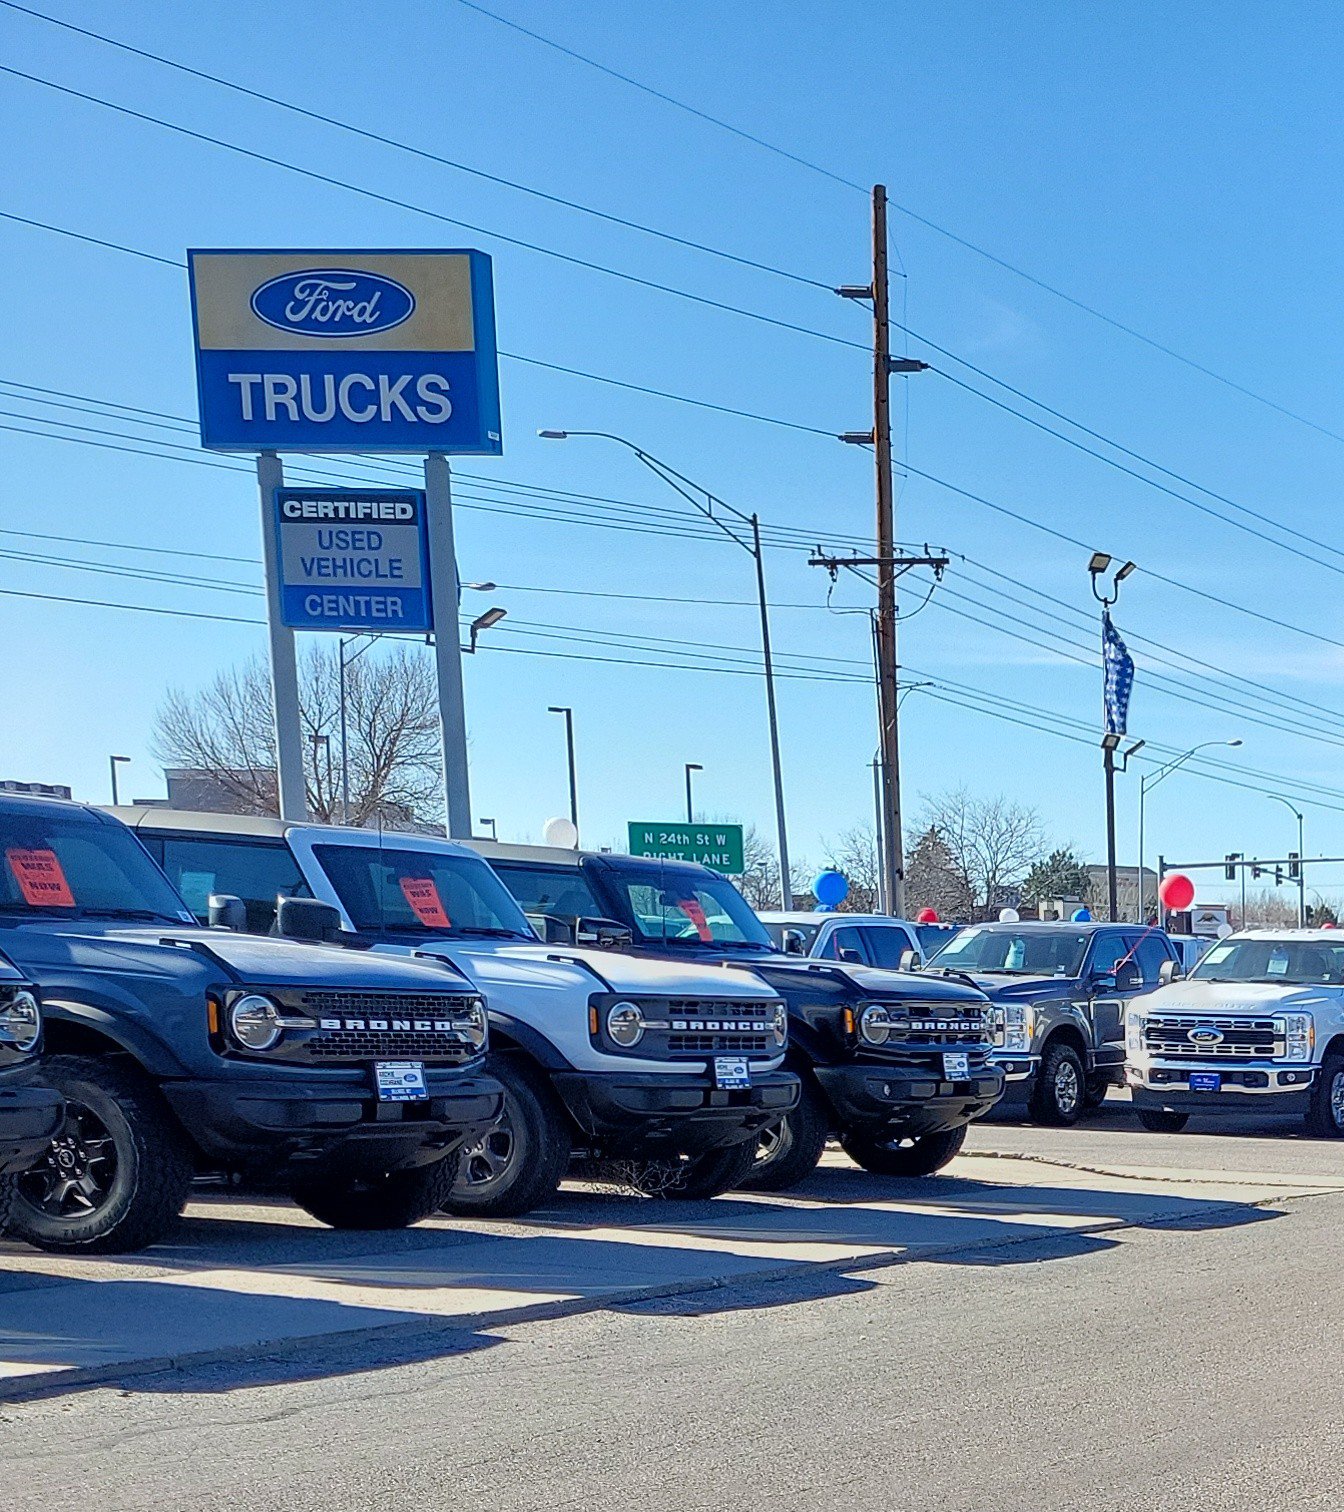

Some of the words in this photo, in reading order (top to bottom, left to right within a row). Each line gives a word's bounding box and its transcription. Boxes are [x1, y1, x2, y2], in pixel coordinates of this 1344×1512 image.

[285, 279, 381, 324] Ford
[228, 374, 453, 424] TRUCKS
[282, 499, 414, 520] CERTIFIED
[317, 529, 383, 551] USED
[300, 557, 403, 580] VEHICLE
[304, 594, 404, 619] CENTER
[644, 832, 654, 844] N
[659, 833, 690, 845] 24th
[696, 834, 710, 846] St
[716, 834, 726, 846] W
[693, 853, 731, 865] LANE
[320, 1019, 451, 1031] BRONCO
[672, 1021, 765, 1031] BRONCO
[911, 1021, 981, 1030] BRONCO
